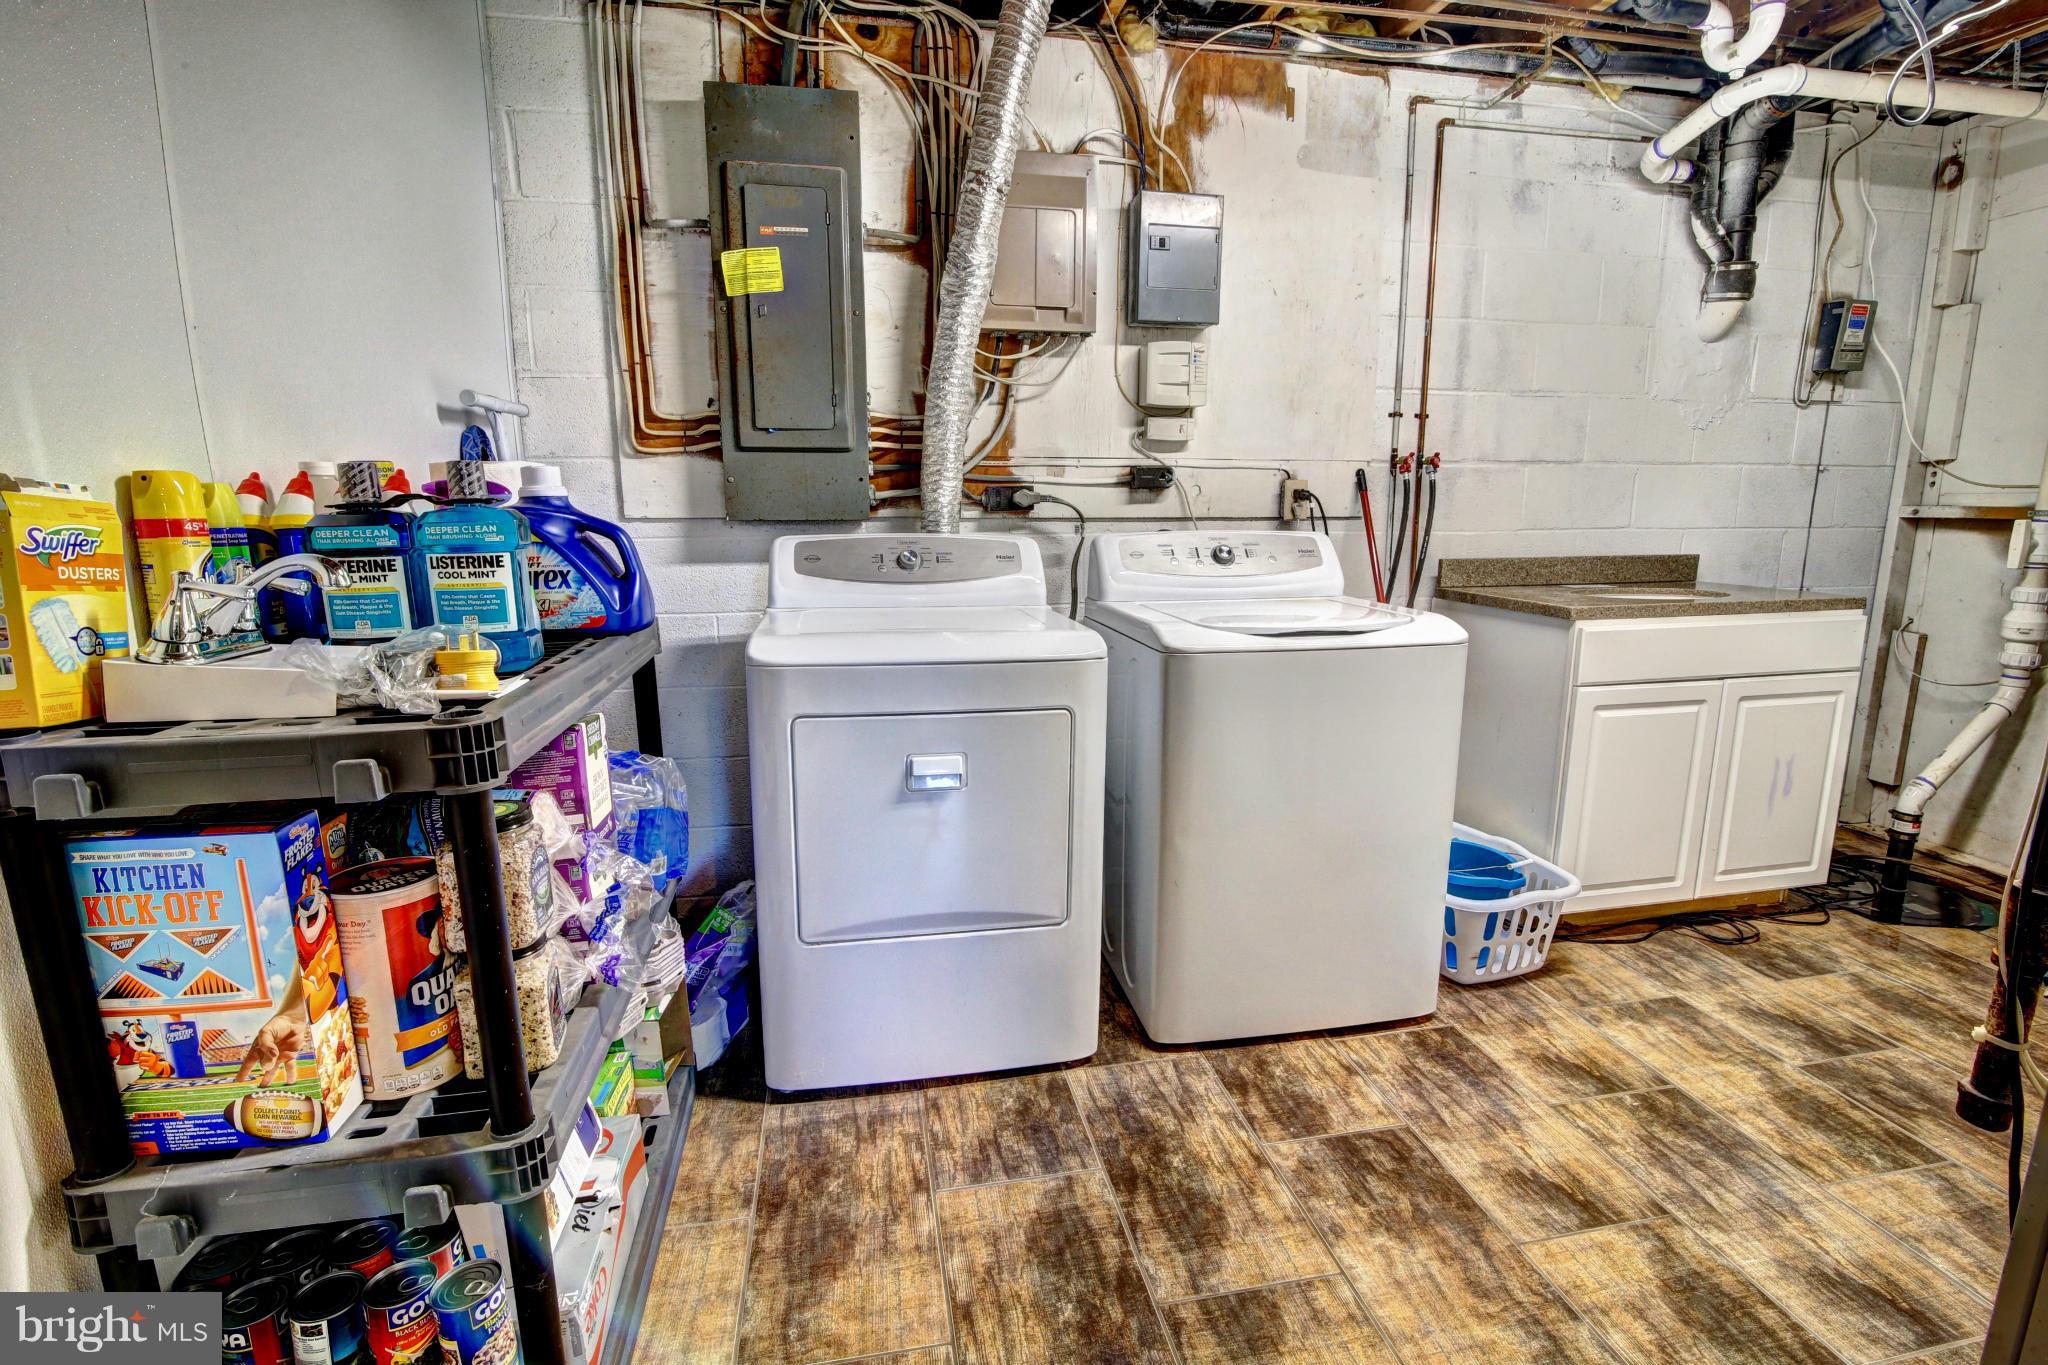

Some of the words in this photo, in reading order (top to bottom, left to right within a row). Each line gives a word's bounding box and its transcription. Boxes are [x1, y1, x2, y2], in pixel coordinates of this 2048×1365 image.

[316, 530, 350, 538] DEEPER
[352, 529, 389, 537] CLEAN
[425, 526, 459, 534] DEEPER
[20, 527, 98, 560] Swiffer
[430, 555, 505, 570] LISTERINE
[58, 566, 120, 580] DUSTERS
[359, 574, 388, 583] MINT
[438, 571, 466, 579] COOL
[468, 570, 496, 578] MINT
[529, 570, 572, 590] rex
[431, 798, 444, 828] BROWN
[284, 827, 315, 863] FROSTED
[286, 843, 314, 872] FLAKES
[92, 863, 206, 893] KITCHEN
[350, 869, 430, 893] QUAKER
[370, 876, 419, 892] OATS
[81, 890, 224, 927] KICK-OFF
[110, 938, 135, 947] FROSTED
[192, 933, 218, 942] FROSTED
[194, 939, 216, 947] FLAKES
[412, 966, 456, 1006] QUA
[165, 1029, 193, 1038] FROSTED
[430, 1024, 448, 1037] OLD
[166, 1034, 191, 1043] FLAKES
[572, 1190, 606, 1233] Diet
[586, 1266, 607, 1333] Coke
[392, 1294, 430, 1324] GO
[395, 1324, 418, 1337] BLACK
